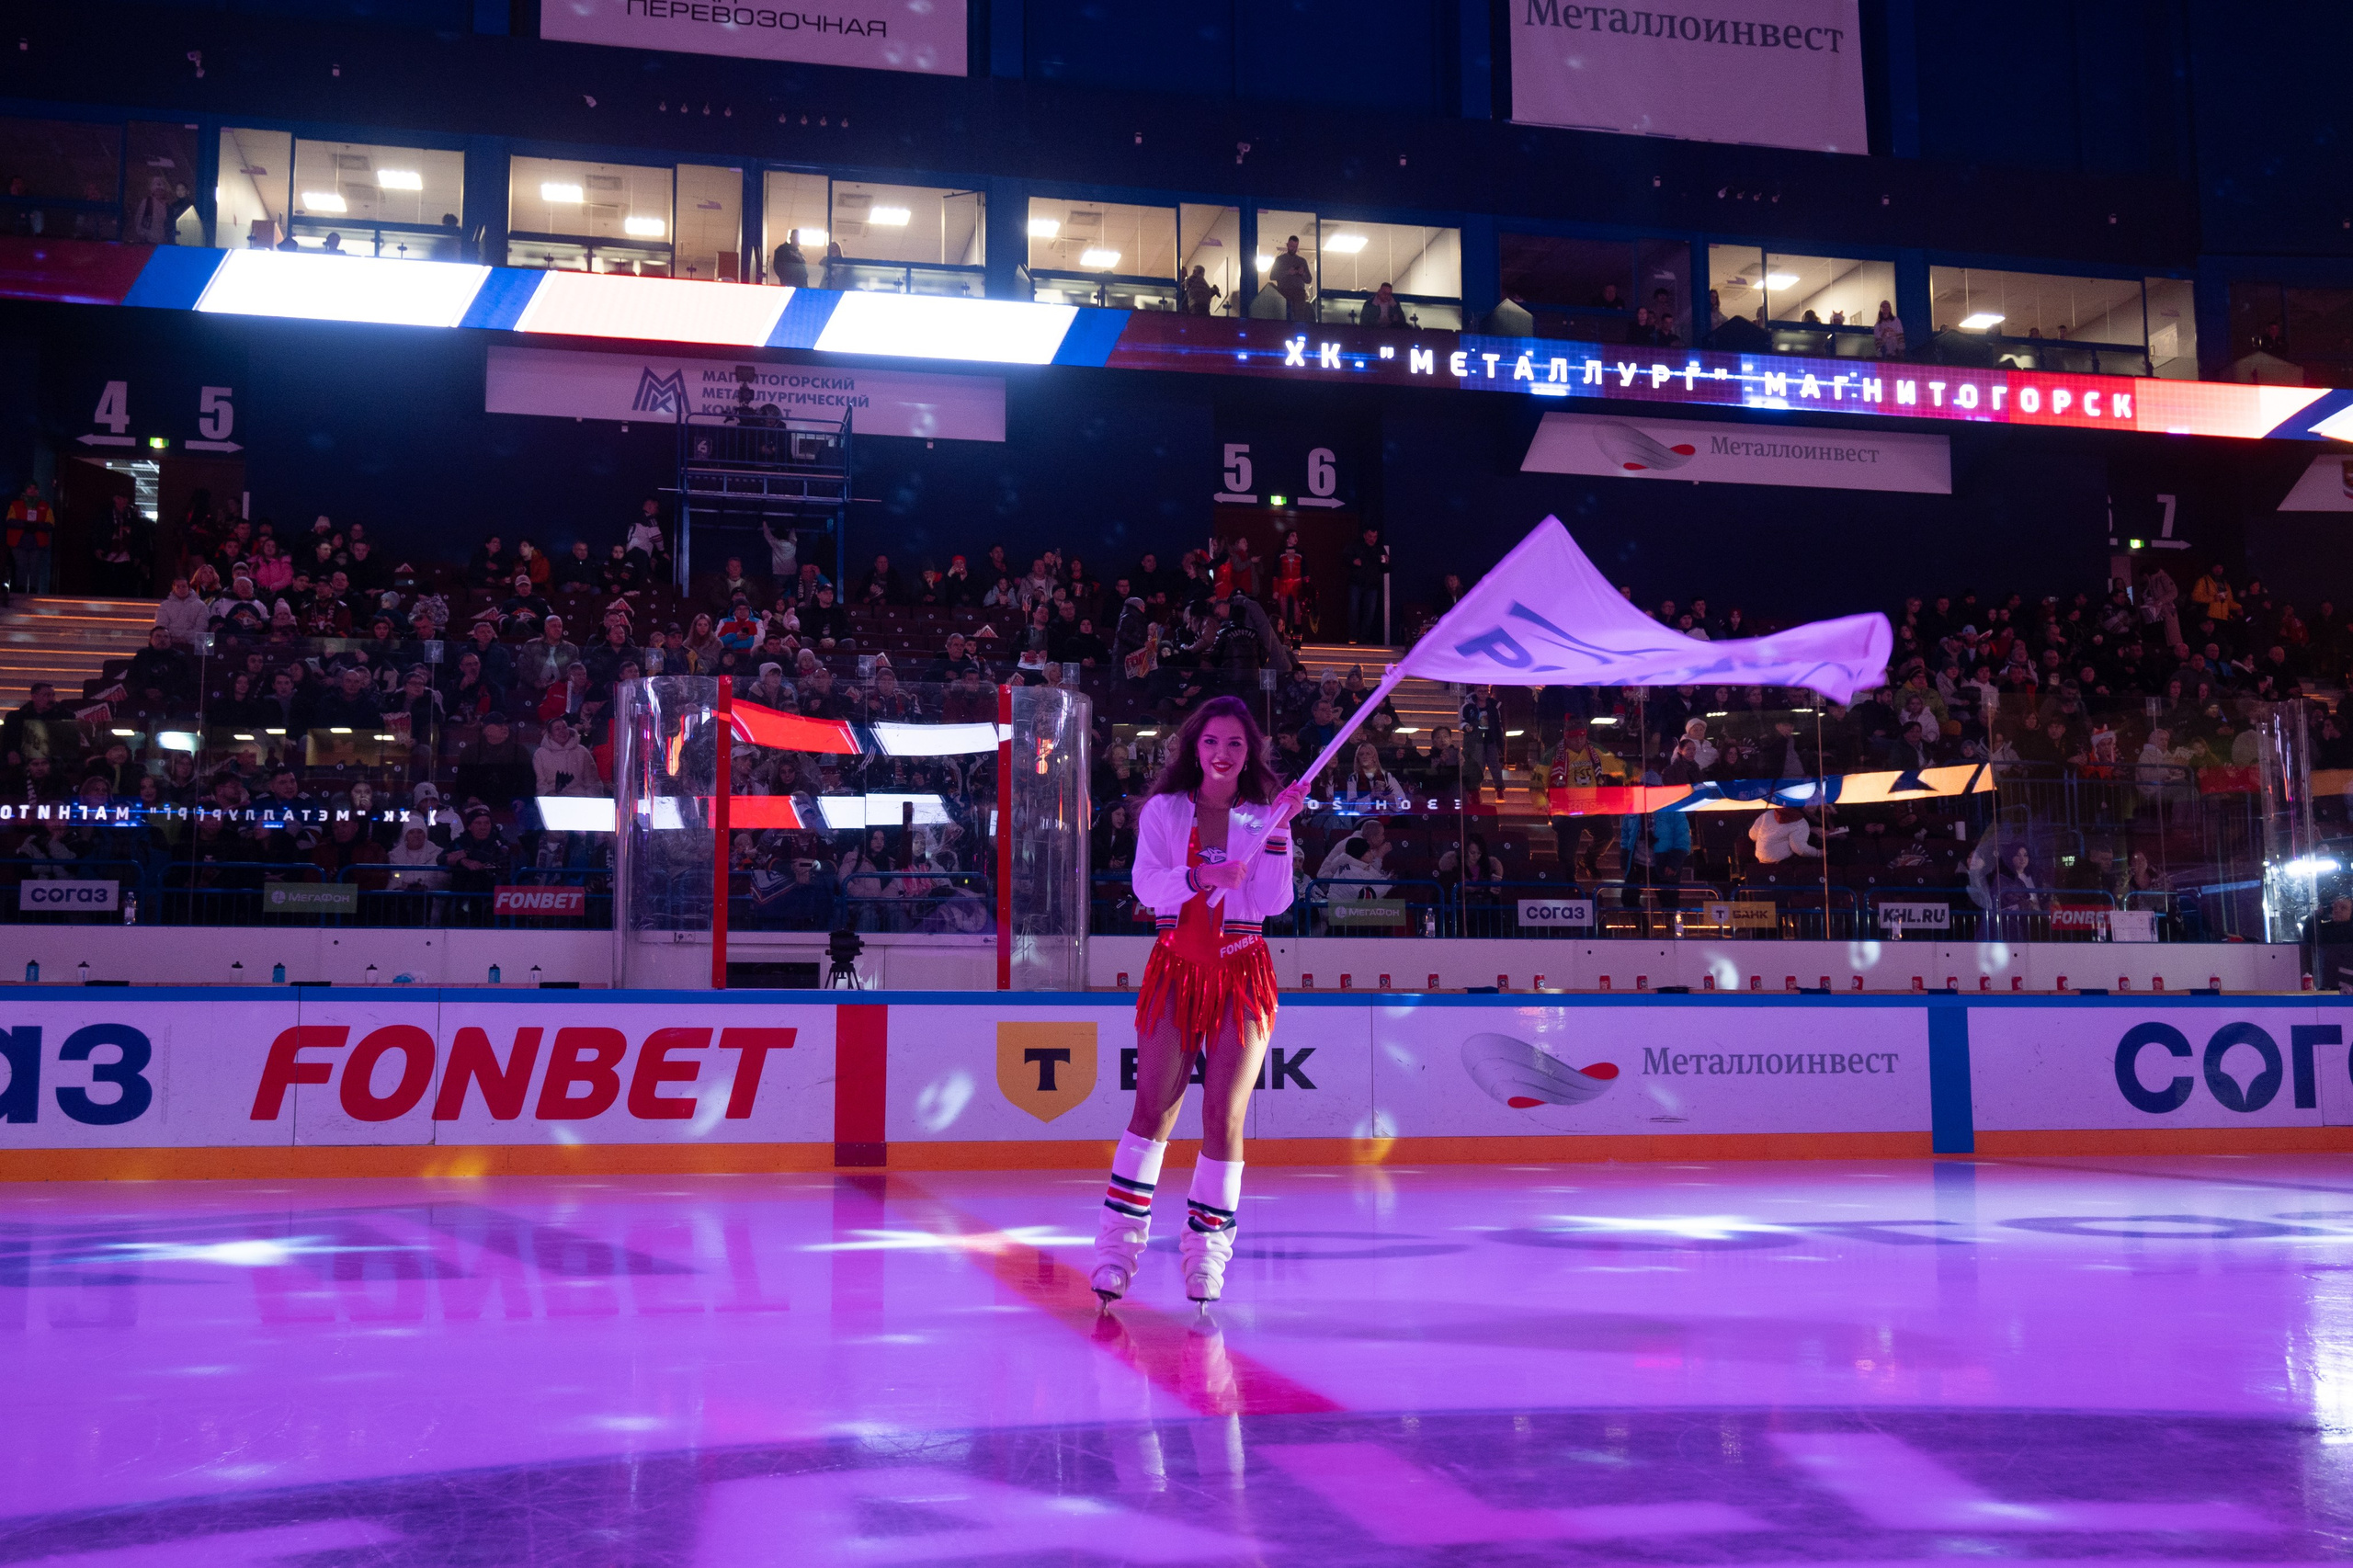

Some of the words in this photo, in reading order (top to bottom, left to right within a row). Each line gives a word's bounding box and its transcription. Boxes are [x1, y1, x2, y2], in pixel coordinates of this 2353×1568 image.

[627, 0, 887, 38] ПЕРЕВОЗОЧНАЯ
[1524, 0, 1845, 53] Металлоинвест
[701, 386, 870, 408] МЕТАЛУРГИЧЕСКИЙ
[702, 369, 855, 391] МАГИТОГОРСКИЙ
[1284, 340, 1341, 369] ХК
[1764, 370, 2132, 418] МАГНИТОГОРСК
[94, 380, 131, 434] 4
[199, 385, 234, 440] 5
[1710, 435, 1881, 463] Металлоинвест
[1223, 443, 1253, 493] 5
[1307, 447, 1336, 497] 6
[2156, 494, 2177, 539] 7
[495, 892, 583, 909] FONBET
[1732, 909, 1768, 919] БАНК
[1881, 908, 1946, 923] KHL.RU
[249, 1024, 799, 1122] FONBET
[1642, 1046, 1900, 1075] Металлоинвест
[2114, 1020, 2353, 1114] сог
